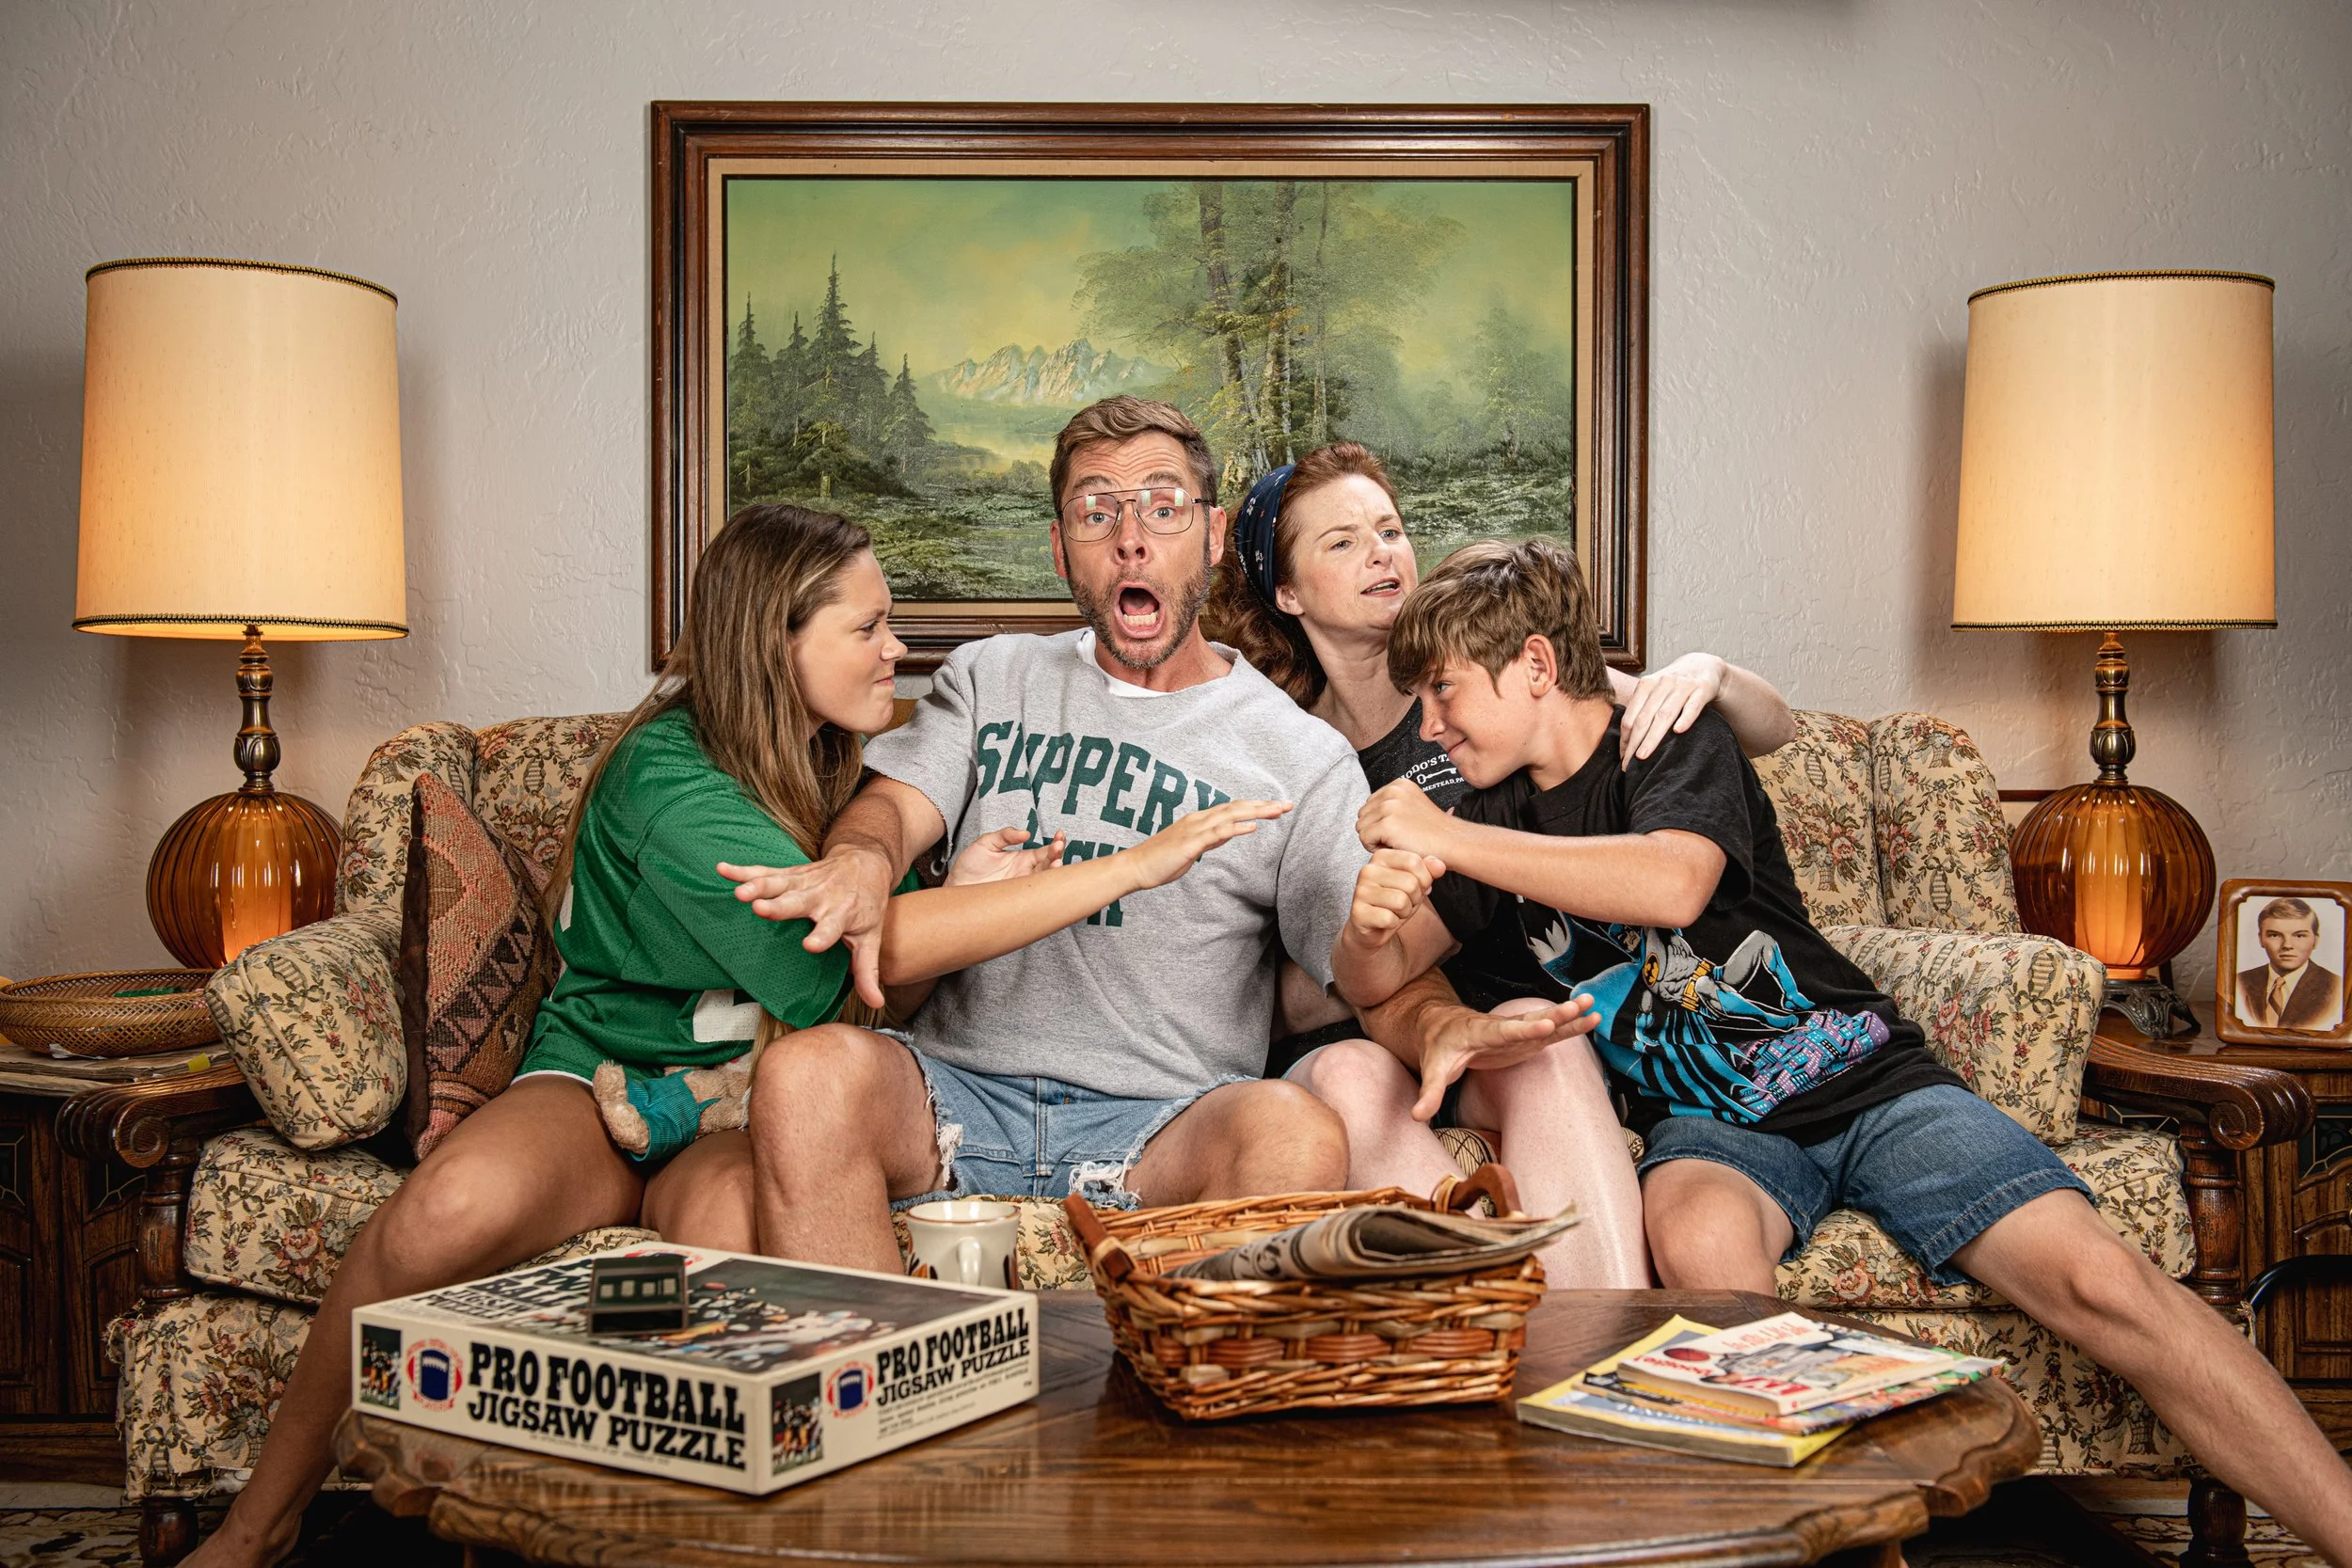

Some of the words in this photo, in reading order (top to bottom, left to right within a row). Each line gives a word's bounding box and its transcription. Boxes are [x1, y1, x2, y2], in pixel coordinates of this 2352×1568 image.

[876, 1364, 954, 1406] JIGSAW
[961, 1338, 1030, 1378] PUZZLE
[877, 1340, 921, 1385] PRO
[926, 1307, 1029, 1366] FOOTBALL
[469, 1341, 540, 1397] PRO
[547, 1354, 746, 1434] FOOTBALL
[467, 1390, 598, 1442] JIGSAW
[607, 1415, 746, 1472] PUZZLE
